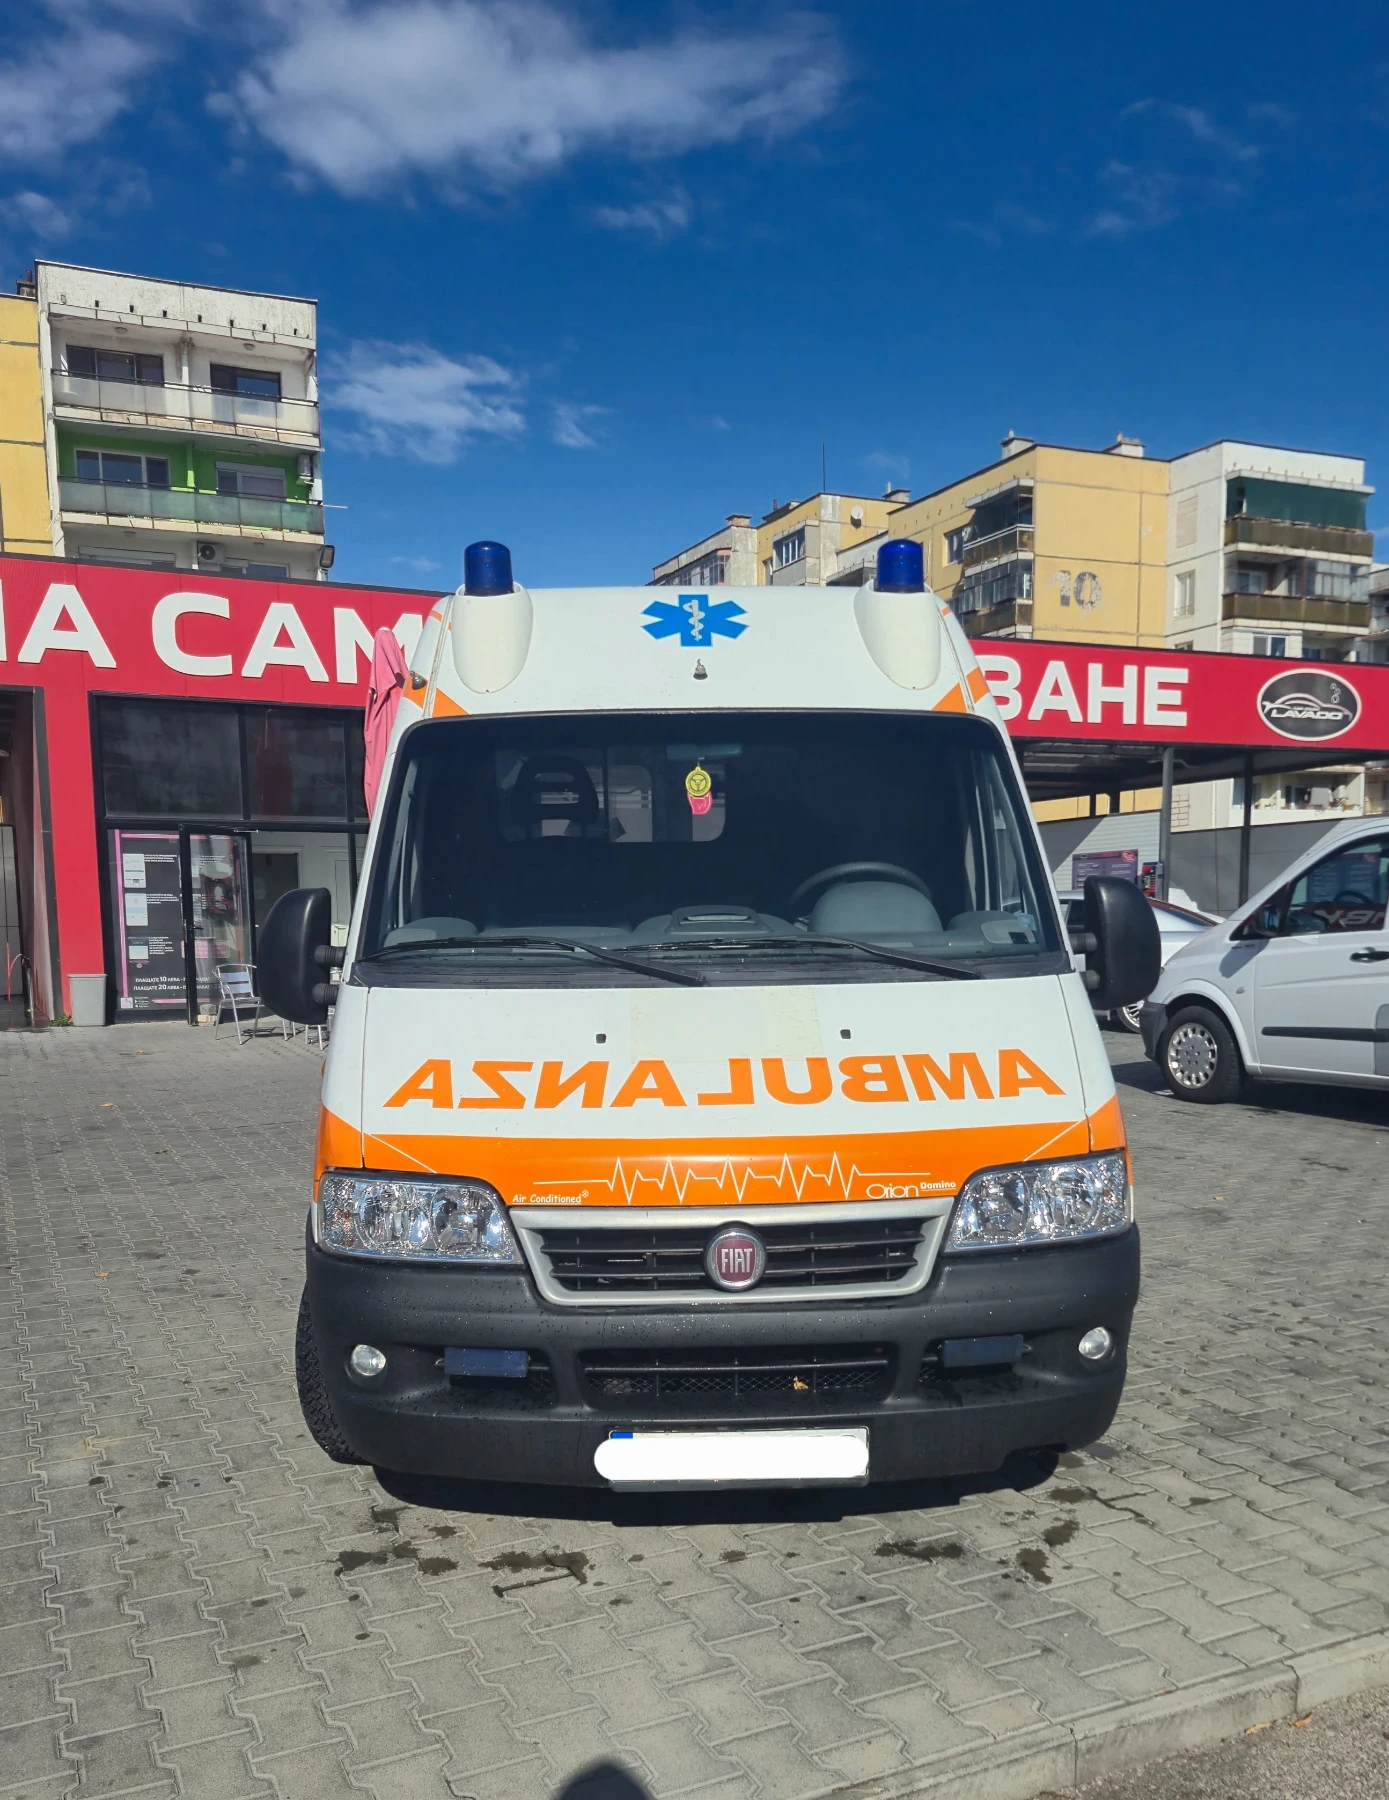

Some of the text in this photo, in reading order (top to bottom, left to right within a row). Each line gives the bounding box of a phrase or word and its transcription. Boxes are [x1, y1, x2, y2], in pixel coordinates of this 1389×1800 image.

[1053, 570, 1101, 610] 10
[0, 578, 117, 669] А
[512, 1193, 582, 1204] Air Conditioned
[866, 1181, 956, 1199] Orion Domino
[721, 1247, 753, 1273] FIAT
